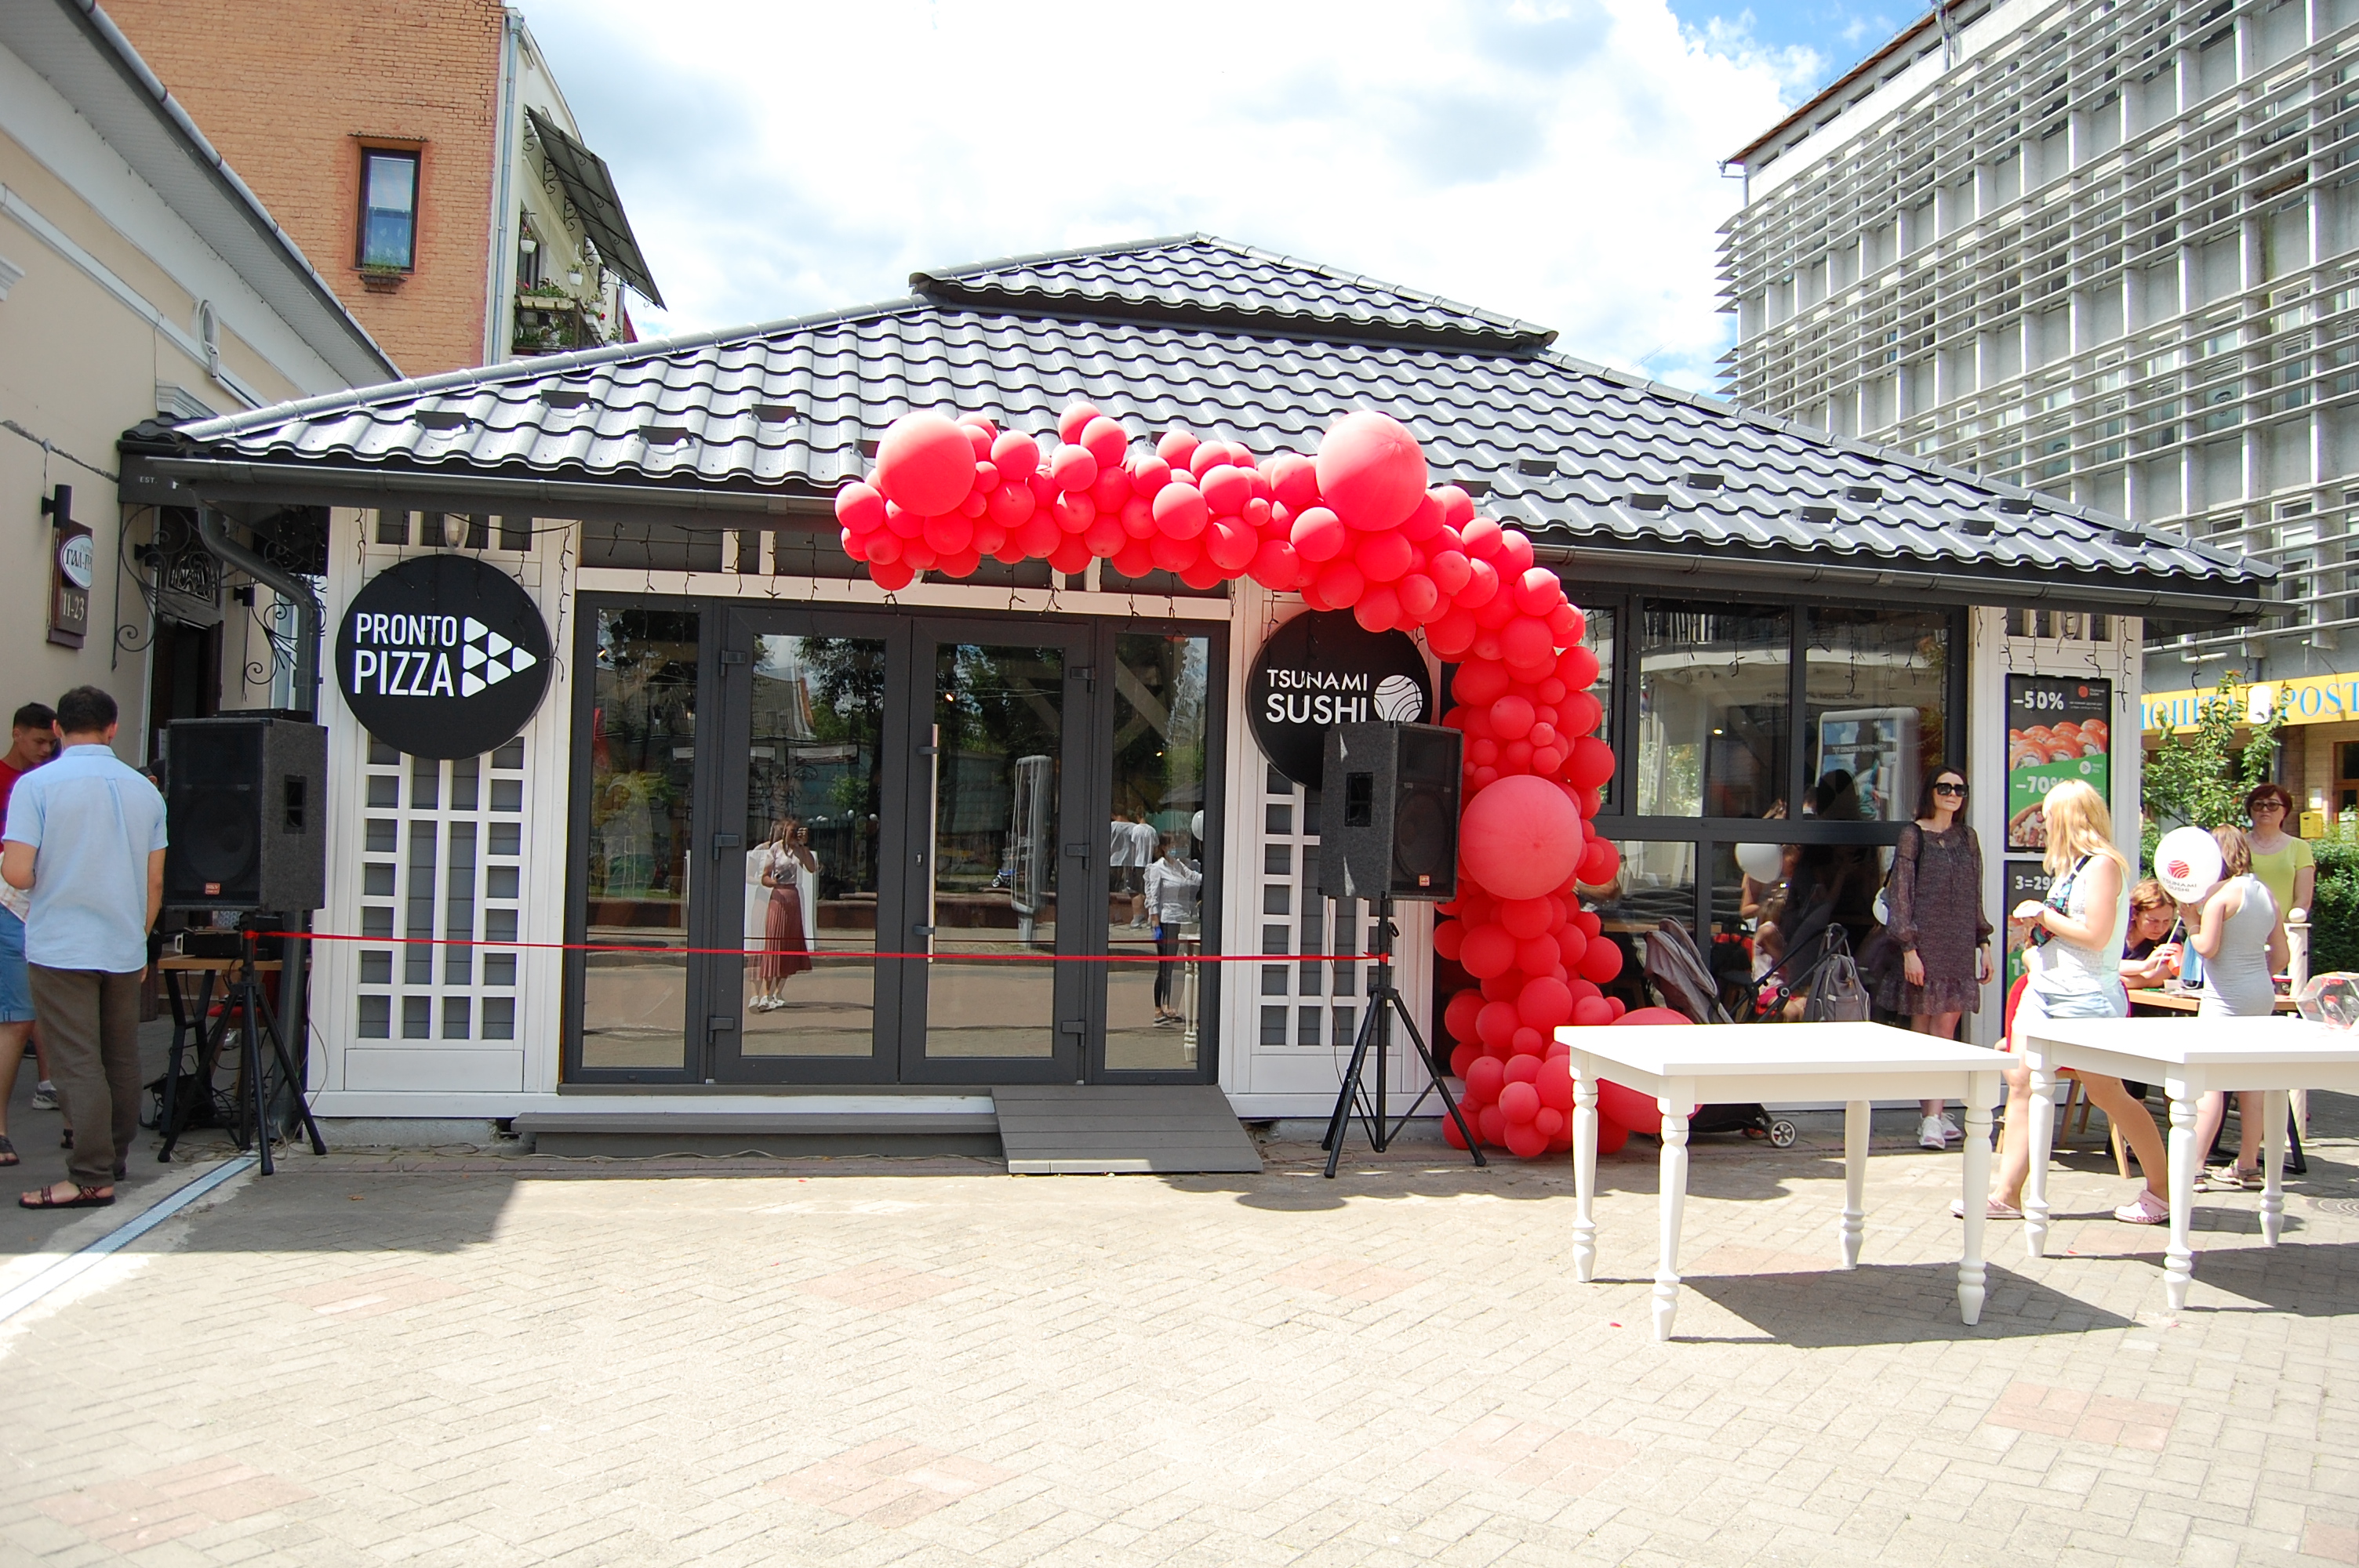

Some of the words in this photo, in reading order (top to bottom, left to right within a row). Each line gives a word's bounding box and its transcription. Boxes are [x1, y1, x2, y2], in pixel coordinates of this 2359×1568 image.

[63, 593, 85, 621] 11-23
[356, 613, 457, 647] PRONTO
[354, 650, 455, 697] PIZZA
[1267, 669, 1368, 691] TSUNAMI
[1266, 693, 1367, 724] SUSHI
[2013, 691, 2064, 710] -50%
[2280, 681, 2359, 717] POST
[2163, 877, 2197, 887] TSUNAMI
